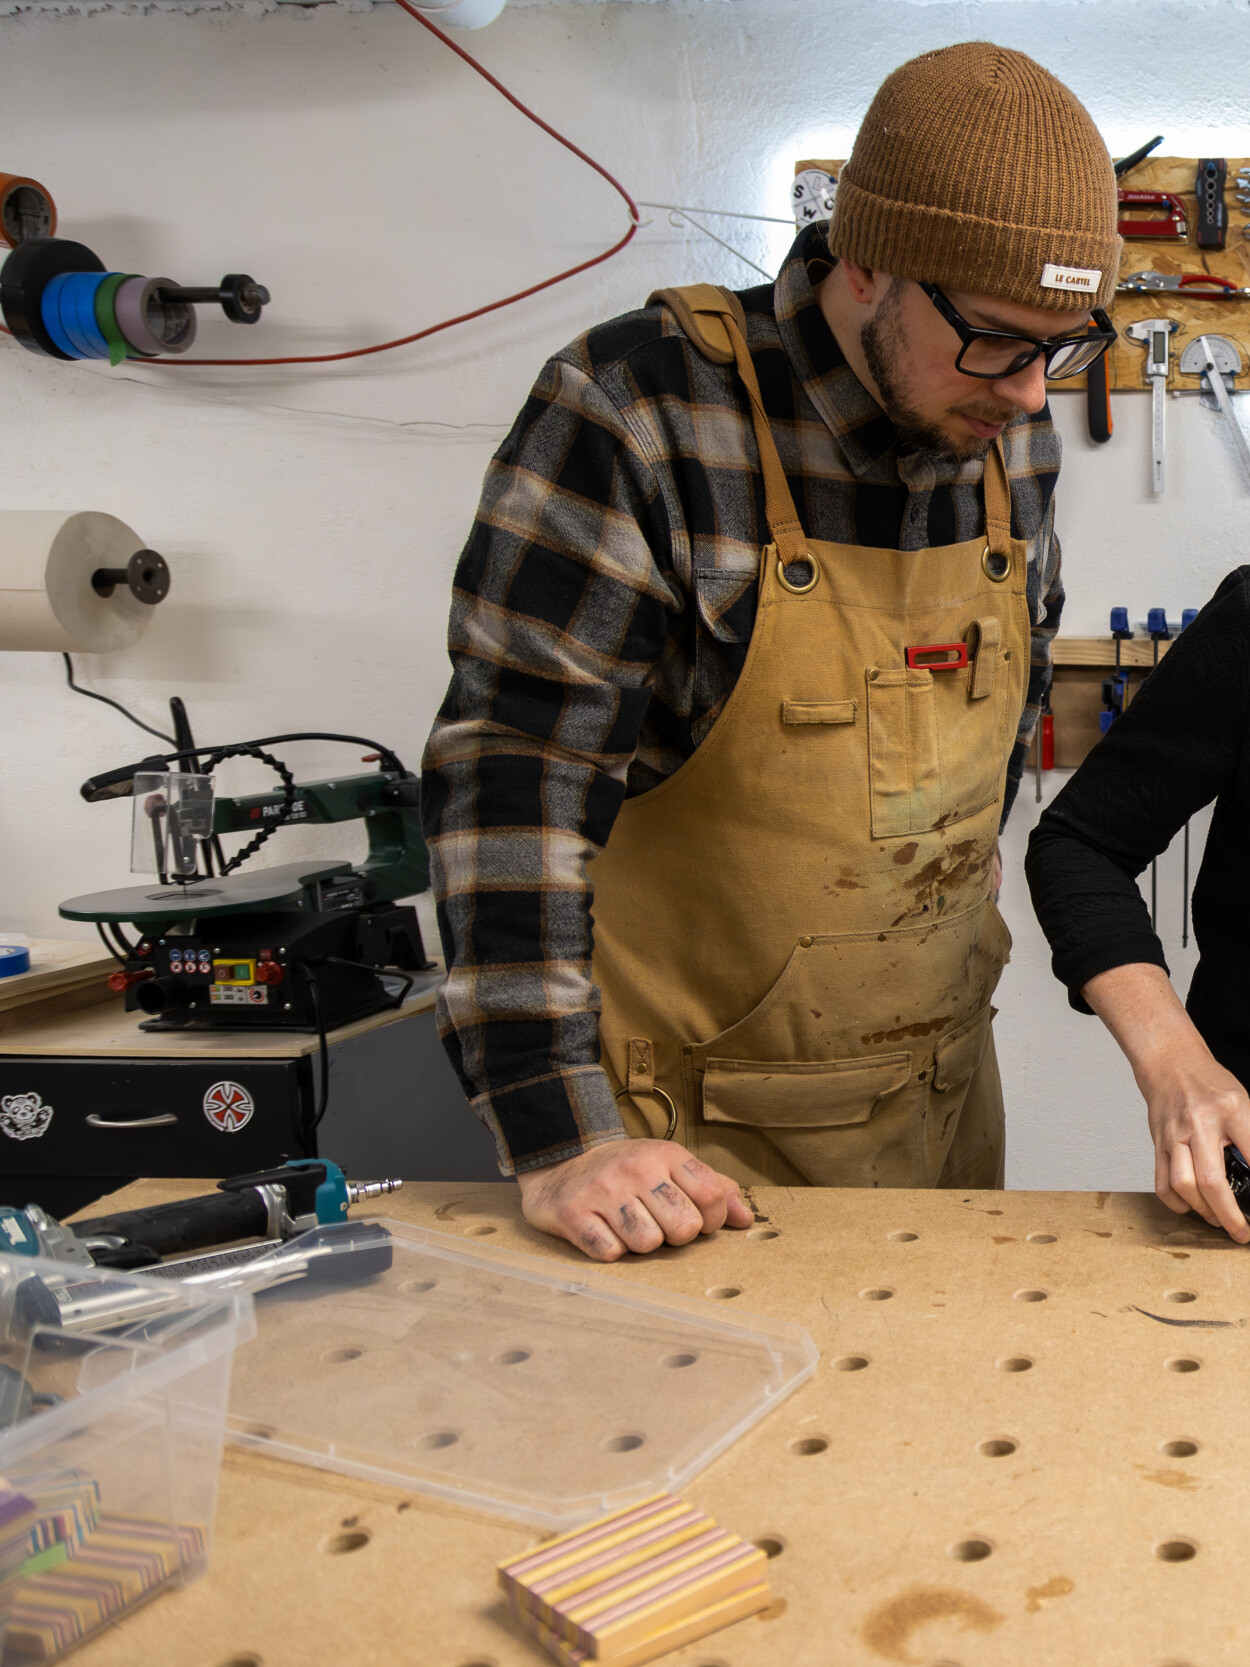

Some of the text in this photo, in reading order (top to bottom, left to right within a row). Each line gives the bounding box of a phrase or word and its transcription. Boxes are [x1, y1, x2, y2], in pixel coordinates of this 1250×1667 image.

[793, 184, 804, 199] S
[803, 205, 817, 219] W
[1055, 273, 1091, 286] LE CARTEL
